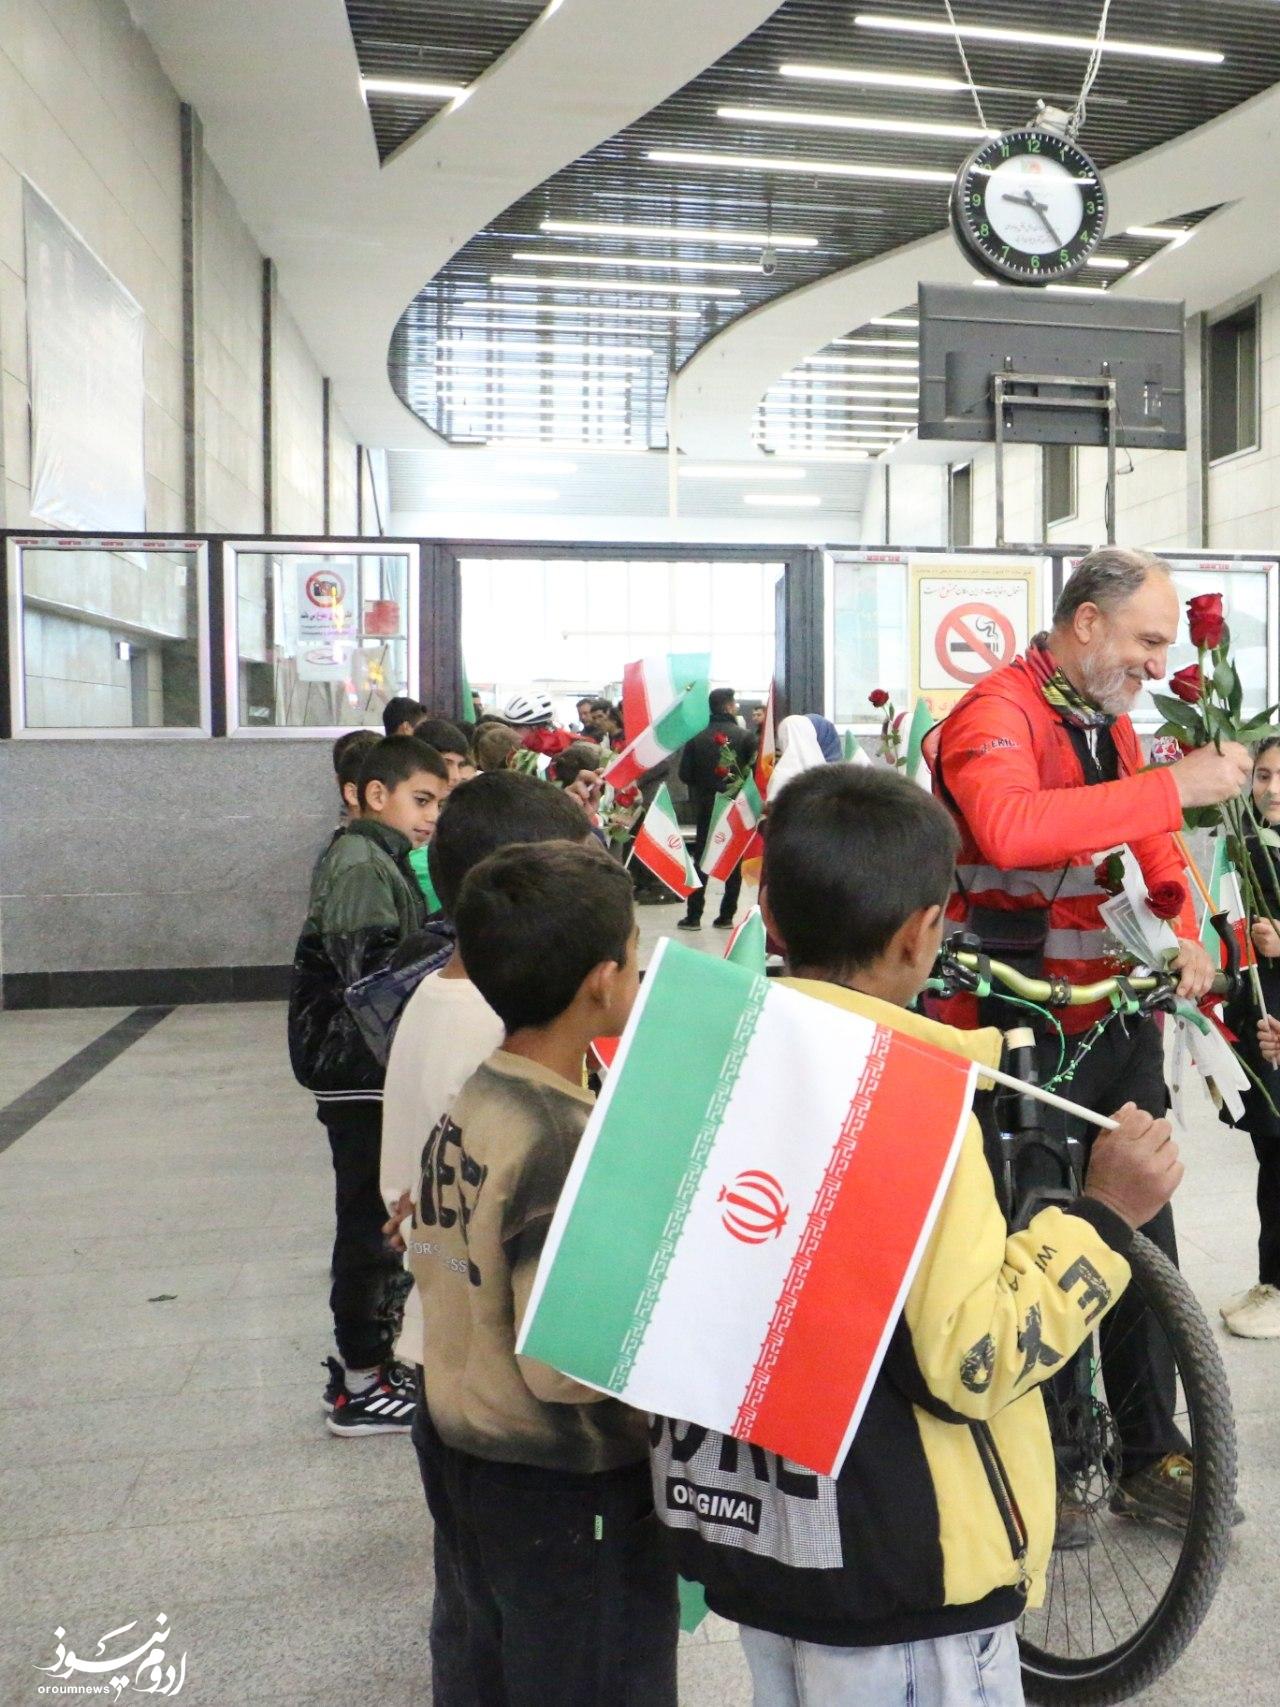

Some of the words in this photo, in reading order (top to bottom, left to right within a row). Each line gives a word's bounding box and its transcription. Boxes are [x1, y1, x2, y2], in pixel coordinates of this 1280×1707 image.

[1001, 145, 1010, 157] 11
[1027, 140, 1041, 154] 12
[1059, 149, 1066, 162] 1
[972, 195, 981, 207] 9
[1086, 201, 1096, 215] 3
[980, 223, 989, 236] 8
[1080, 230, 1089, 242] 4
[1001, 245, 1010, 258] 7
[1060, 249, 1069, 262] 5
[1031, 255, 1040, 268] 6
[673, 1484, 755, 1525] ORGINAL
